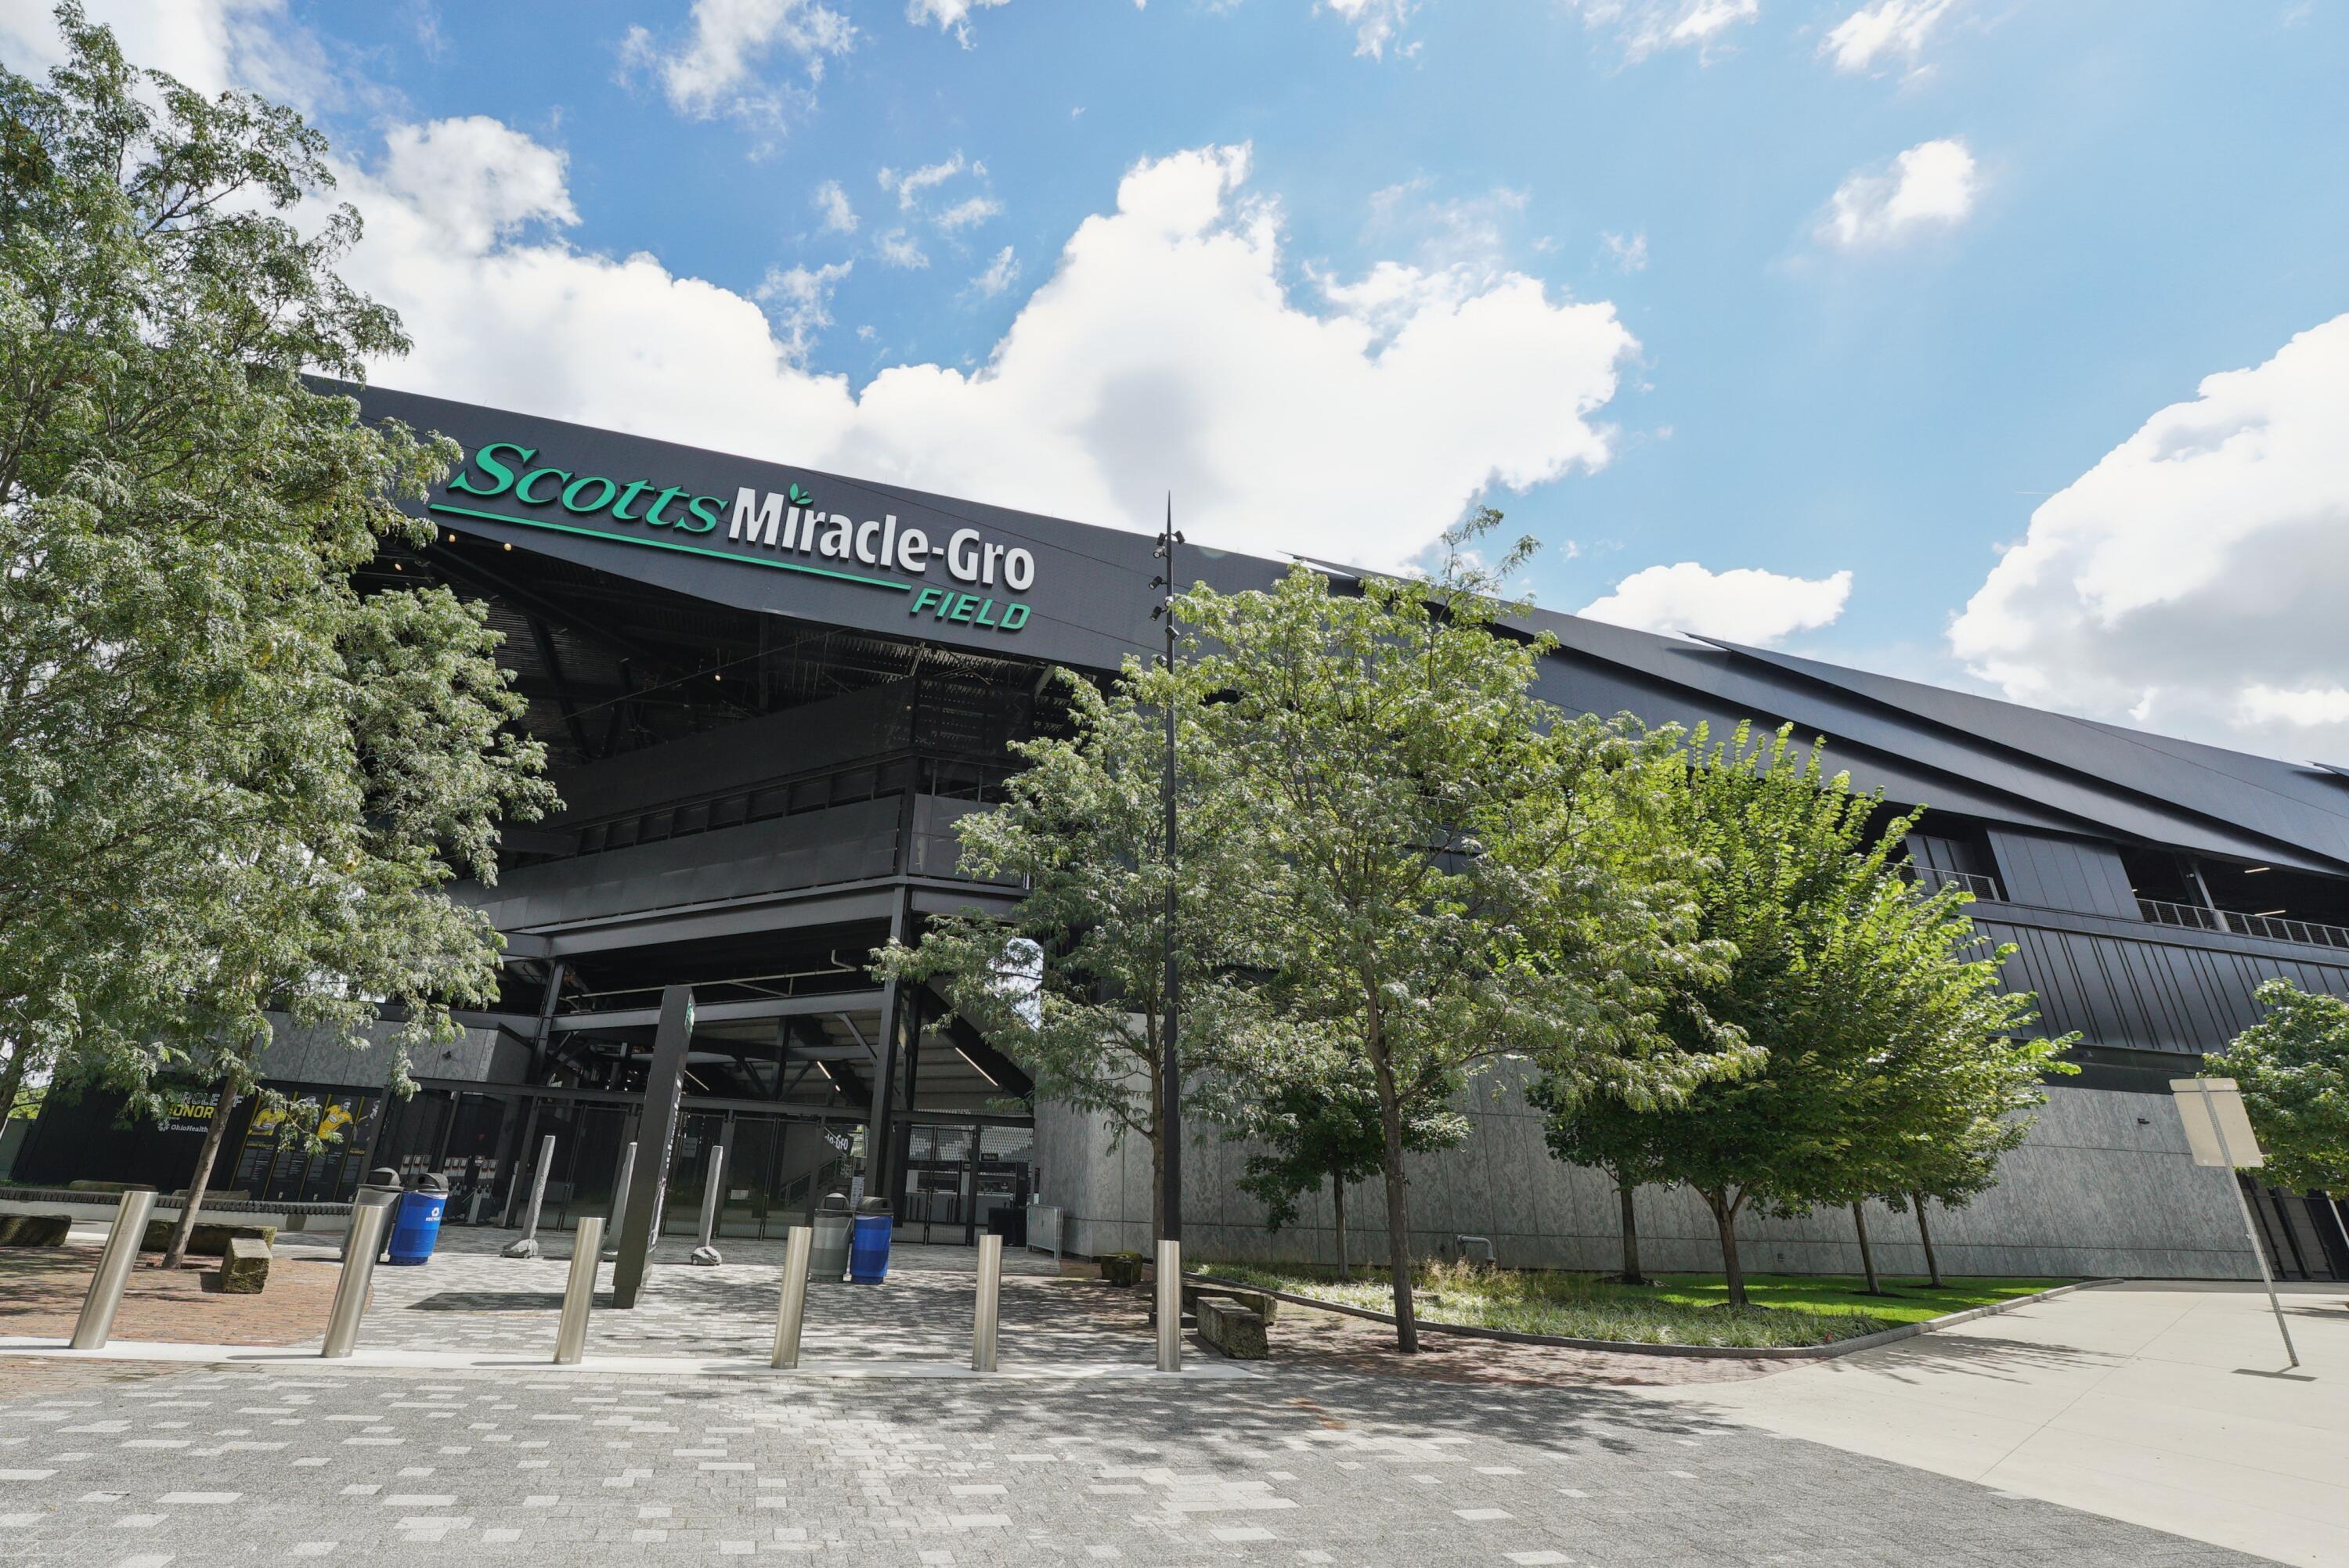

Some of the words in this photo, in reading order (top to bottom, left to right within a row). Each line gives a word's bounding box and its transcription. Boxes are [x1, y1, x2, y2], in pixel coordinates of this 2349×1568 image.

[447, 442, 730, 534] Scotts
[728, 484, 1036, 592] Miracle-Gro
[909, 589, 1031, 631] FIELD
[171, 1123, 208, 1133] OhioHealth
